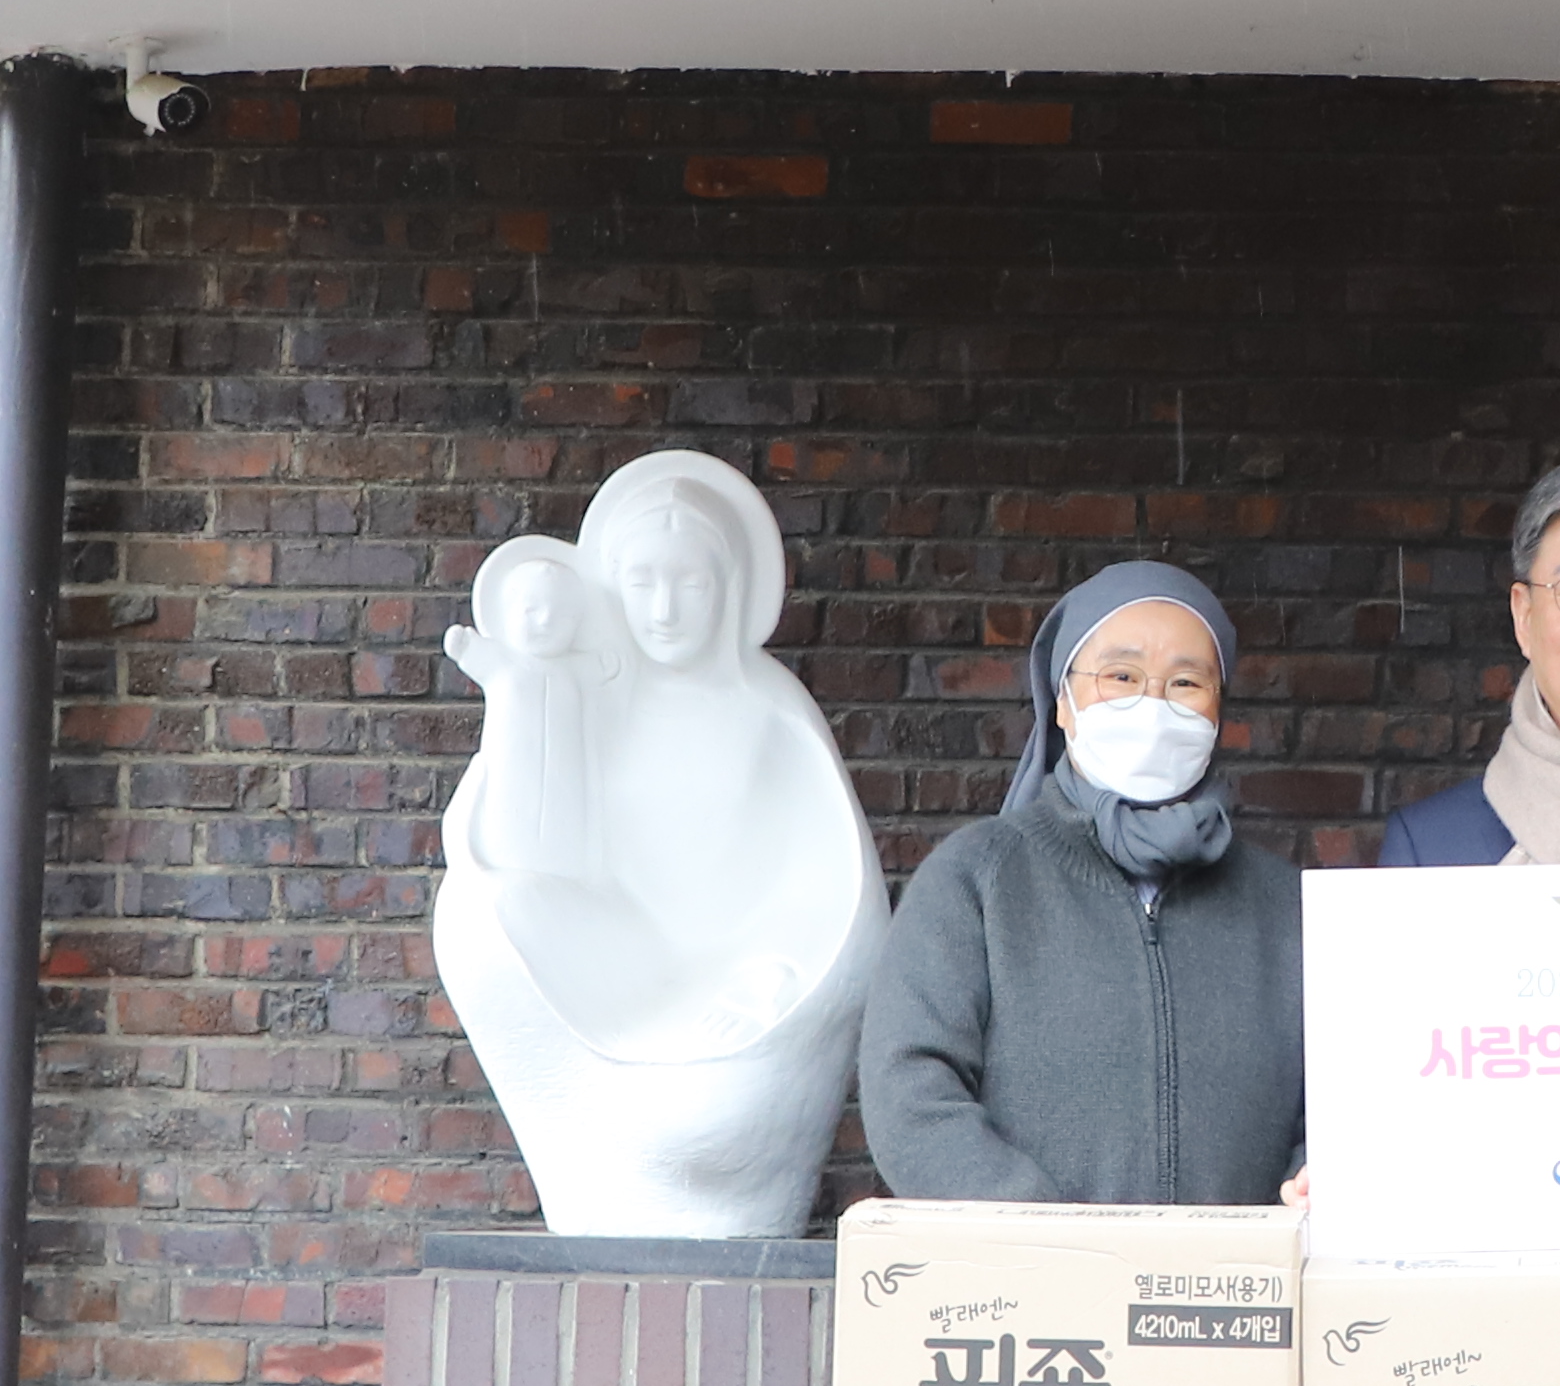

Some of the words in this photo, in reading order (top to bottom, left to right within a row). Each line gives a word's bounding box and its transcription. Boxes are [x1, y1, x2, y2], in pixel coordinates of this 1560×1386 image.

[1134, 1274, 1283, 1302] 옐로미모사(용기)
[1134, 1315, 1205, 1339] 4210mL
[1212, 1324, 1223, 1340] x
[1229, 1317, 1281, 1344] 4개입
